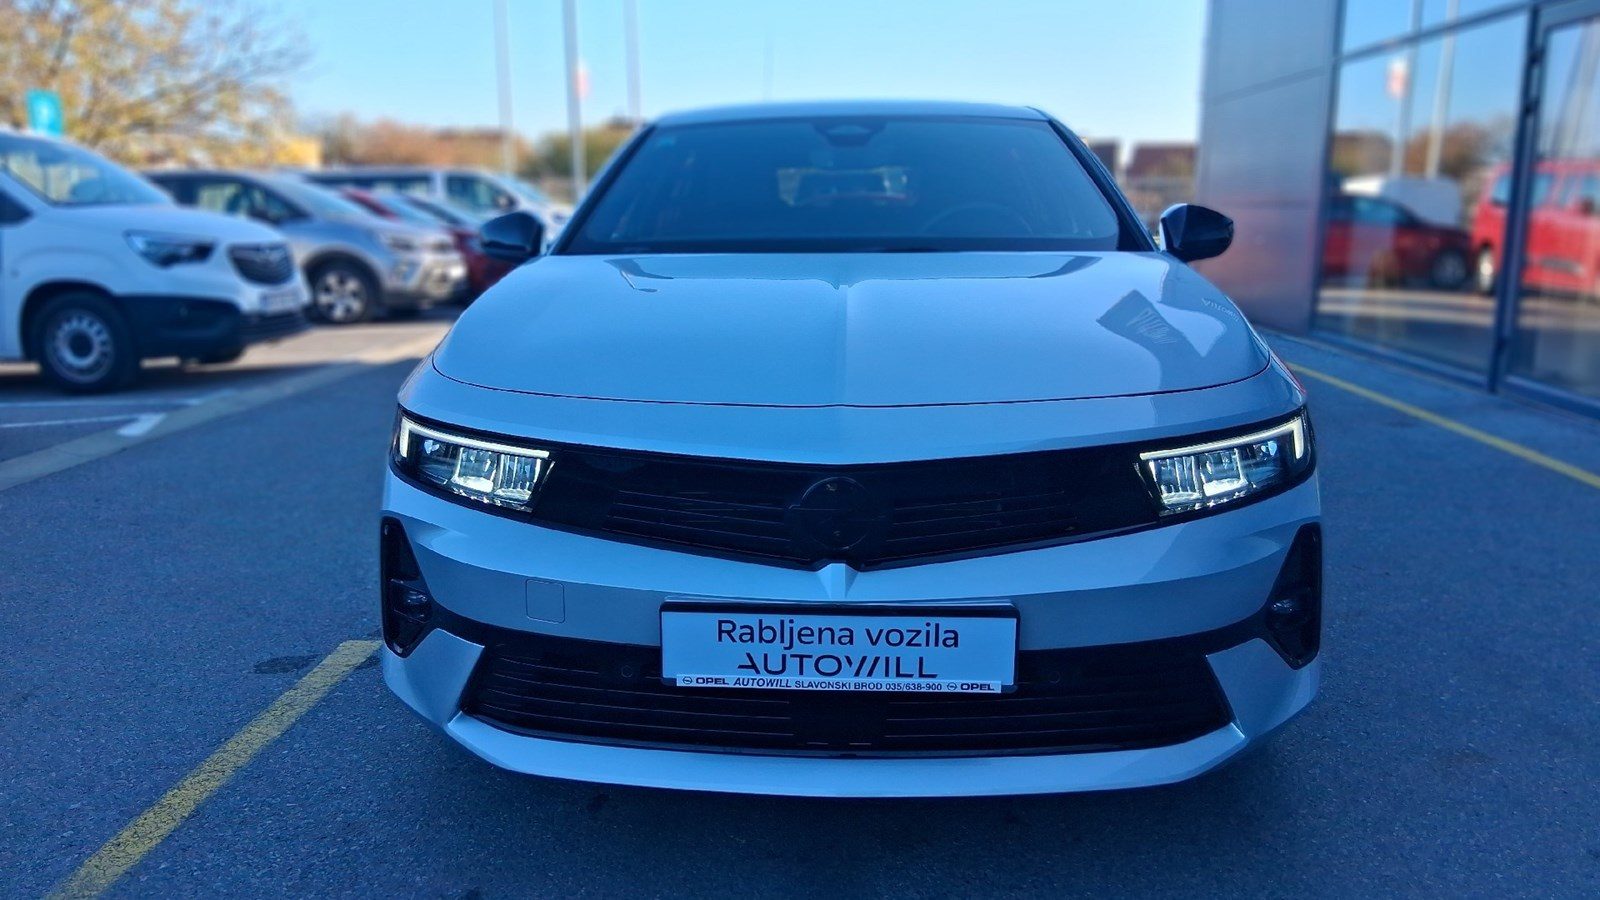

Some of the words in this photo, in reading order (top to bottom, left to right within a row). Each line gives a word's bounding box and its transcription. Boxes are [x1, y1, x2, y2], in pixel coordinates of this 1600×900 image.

[717, 618, 854, 650] Rabljena
[865, 622, 959, 648] vozila
[737, 652, 938, 678] AUTOWILL
[695, 677, 729, 685] OPEL
[733, 677, 792, 688] AUTOWILL
[795, 680, 851, 690] SLAVONSKI
[853, 682, 883, 691] BROD
[885, 682, 942, 692] 035/638-900
[960, 683, 995, 691] OPEL
